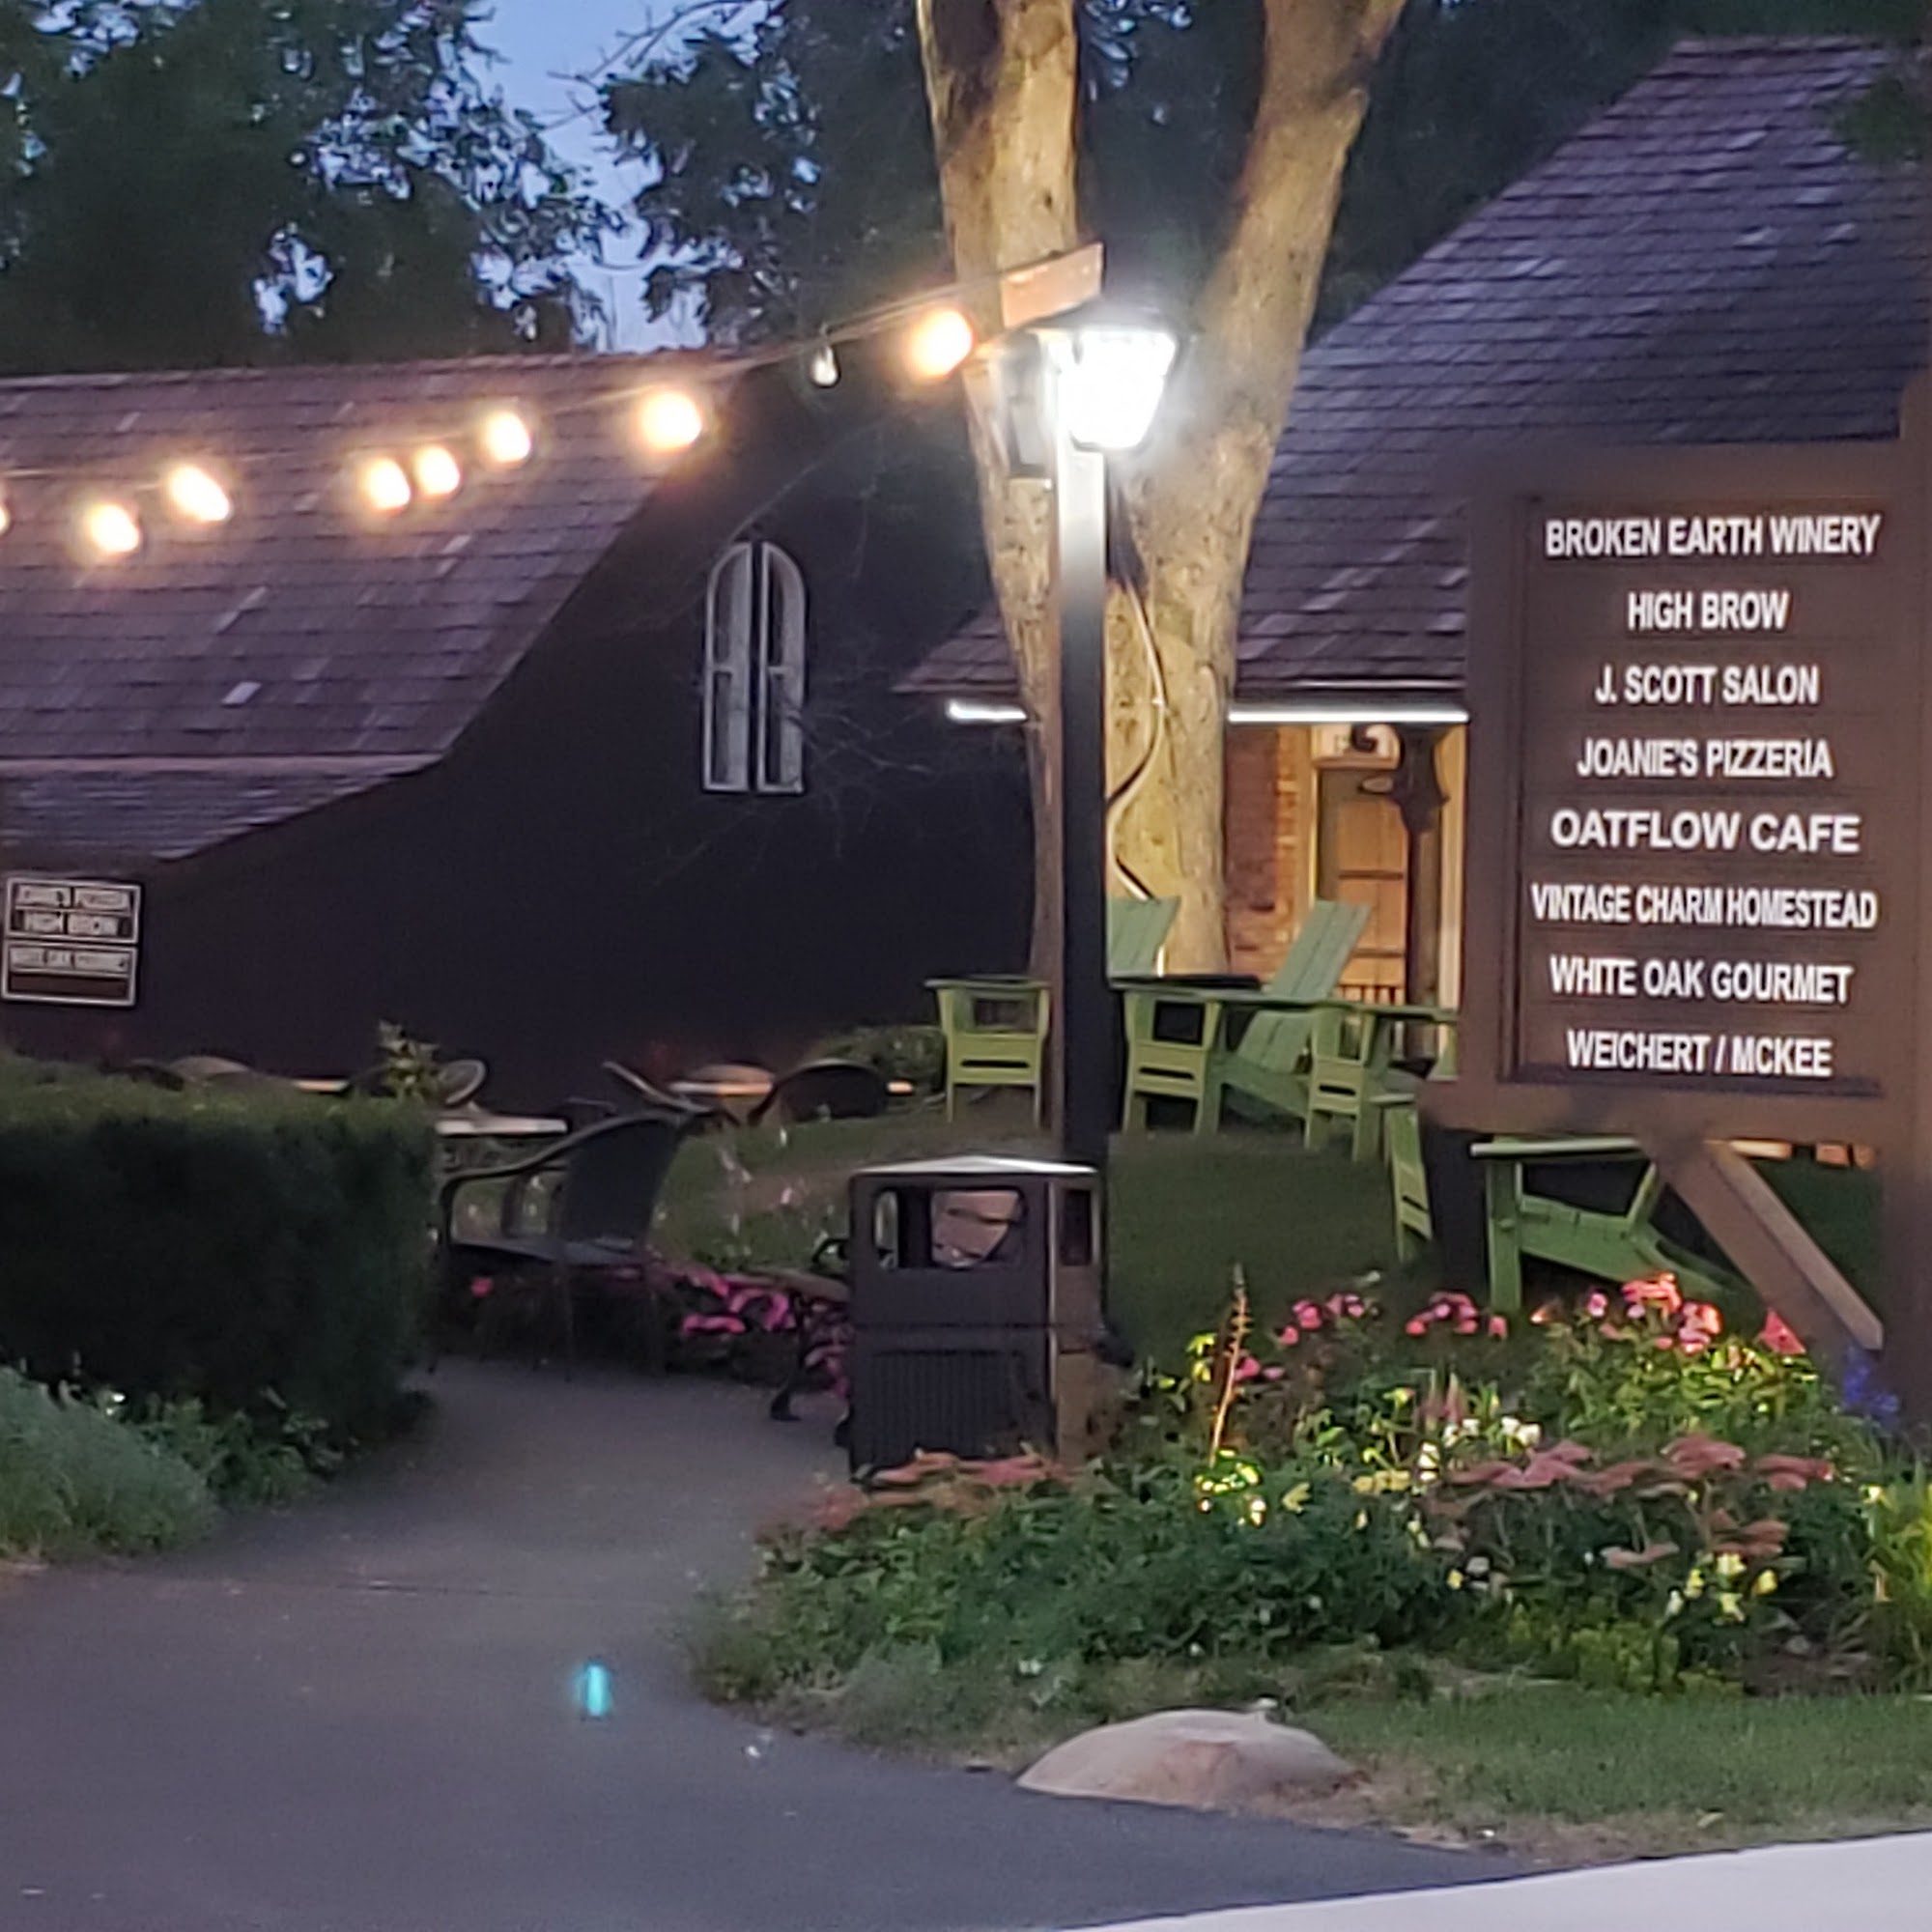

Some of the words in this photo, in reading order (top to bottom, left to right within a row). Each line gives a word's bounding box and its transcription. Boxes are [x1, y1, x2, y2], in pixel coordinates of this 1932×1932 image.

[1545, 518, 1661, 556] BROKEN
[1667, 516, 1762, 555] EARTH
[1769, 514, 1881, 554] WINERY
[1628, 590, 1692, 630] HIGH
[1700, 590, 1790, 629] BROW
[1594, 664, 1618, 703] J.
[1624, 665, 1718, 703] SCOTT
[1722, 665, 1819, 704] SALON
[1577, 737, 1699, 777] JOANIE'S
[1706, 738, 1833, 778] PIZZERIA
[1549, 809, 1742, 850] OATFLOW
[1748, 813, 1861, 853] CAFE
[1530, 882, 1632, 922] VINTAGE
[1635, 885, 1723, 924] CHARM
[1726, 888, 1878, 928] HOMESTEAD
[1549, 953, 1637, 995] WHITE
[1643, 959, 1705, 998] OAK
[1711, 960, 1854, 1004] GOURMET
[1566, 1029, 1711, 1071] WEICHERT
[1713, 1035, 1726, 1073] /
[1730, 1036, 1833, 1077] MCKEE
